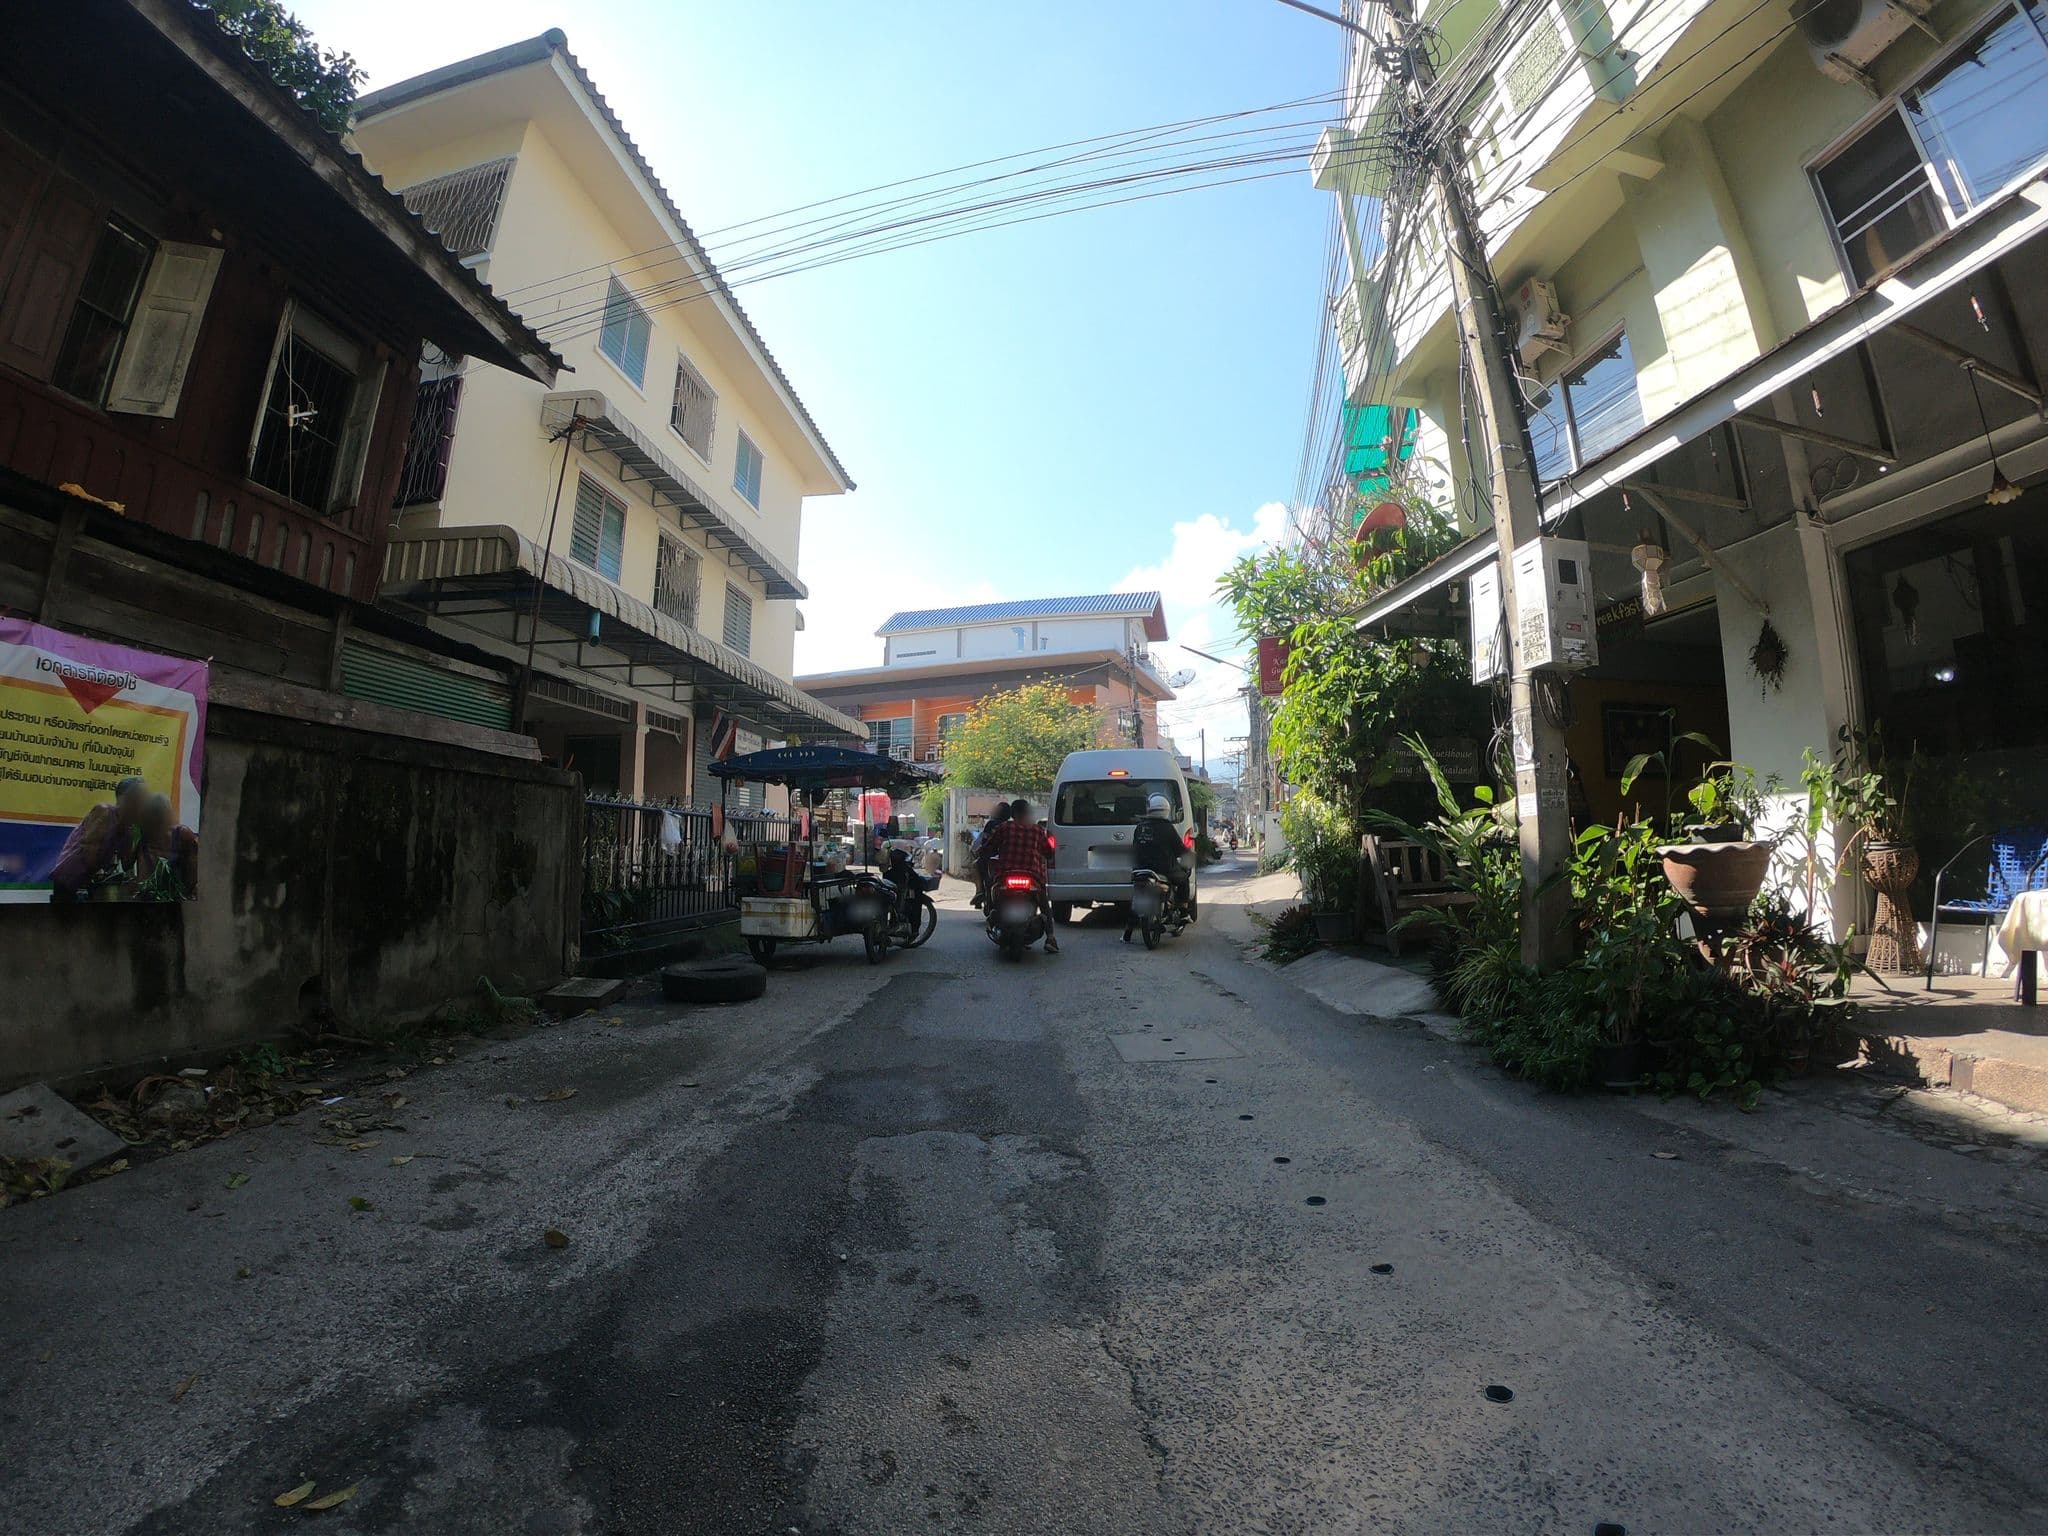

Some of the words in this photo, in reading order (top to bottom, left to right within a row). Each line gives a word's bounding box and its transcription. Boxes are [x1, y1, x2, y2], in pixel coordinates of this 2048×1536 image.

[1596, 596, 1641, 625] reakfast
[36, 656, 138, 690] เอกสารที่ต้องใช้
